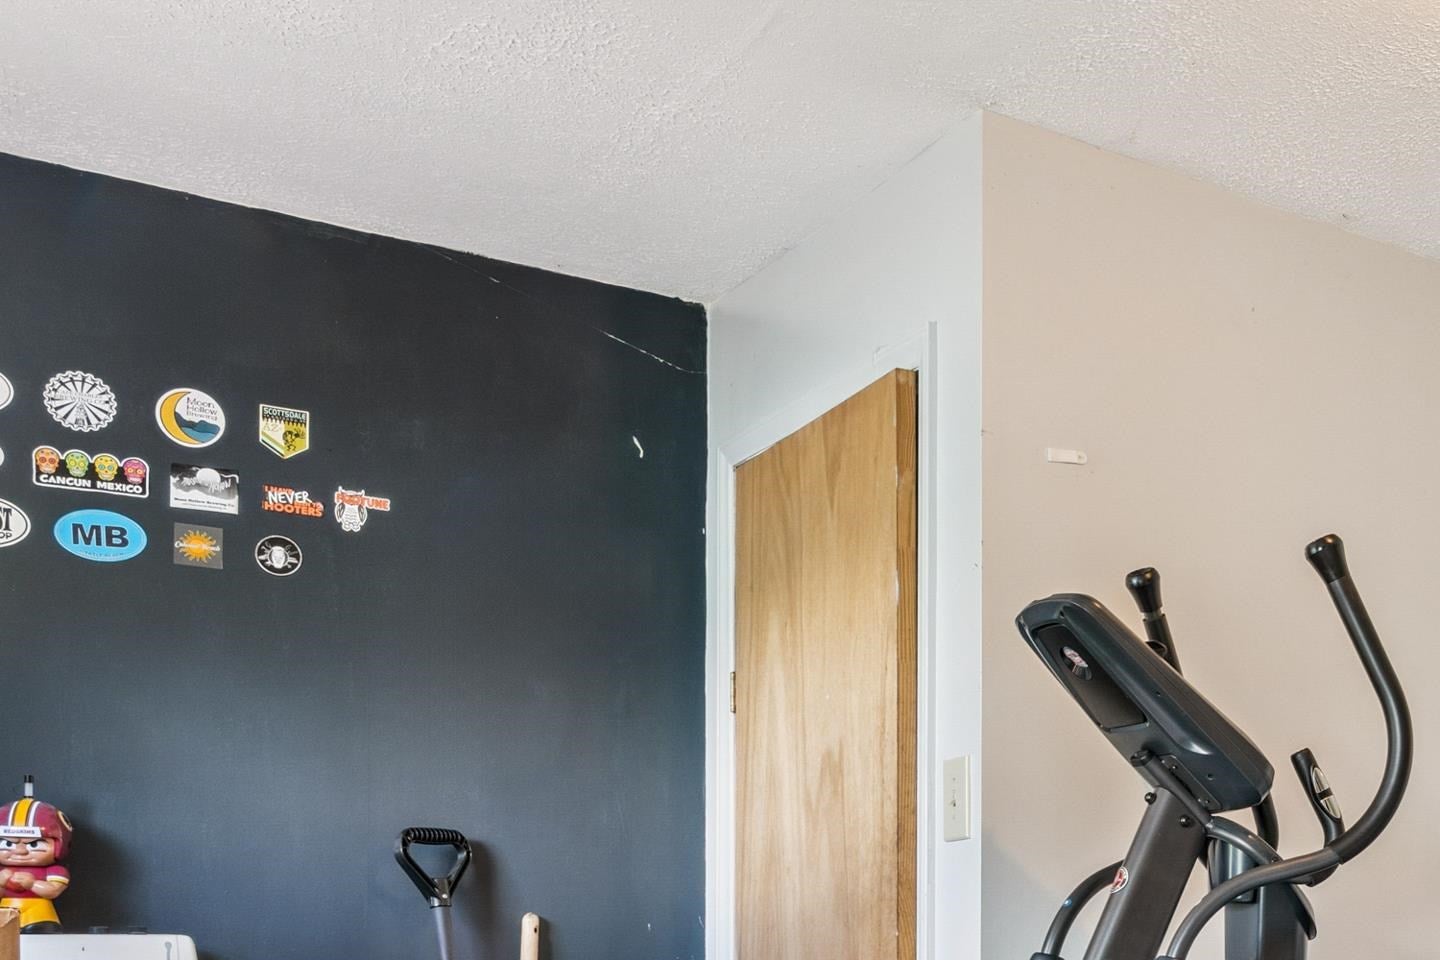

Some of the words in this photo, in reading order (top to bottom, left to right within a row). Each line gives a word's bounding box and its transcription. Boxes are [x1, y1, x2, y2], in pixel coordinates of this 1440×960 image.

[186, 396, 215, 409] Moon
[186, 405, 218, 415] Hollow
[186, 411, 218, 421] Brewing
[263, 407, 306, 420] SCOTTSDALE
[39, 474, 92, 488] CANCUN
[96, 481, 143, 494] MEXICO
[268, 491, 313, 505] NEVER
[264, 501, 323, 518] HOOTERS
[71, 523, 129, 548] MB
